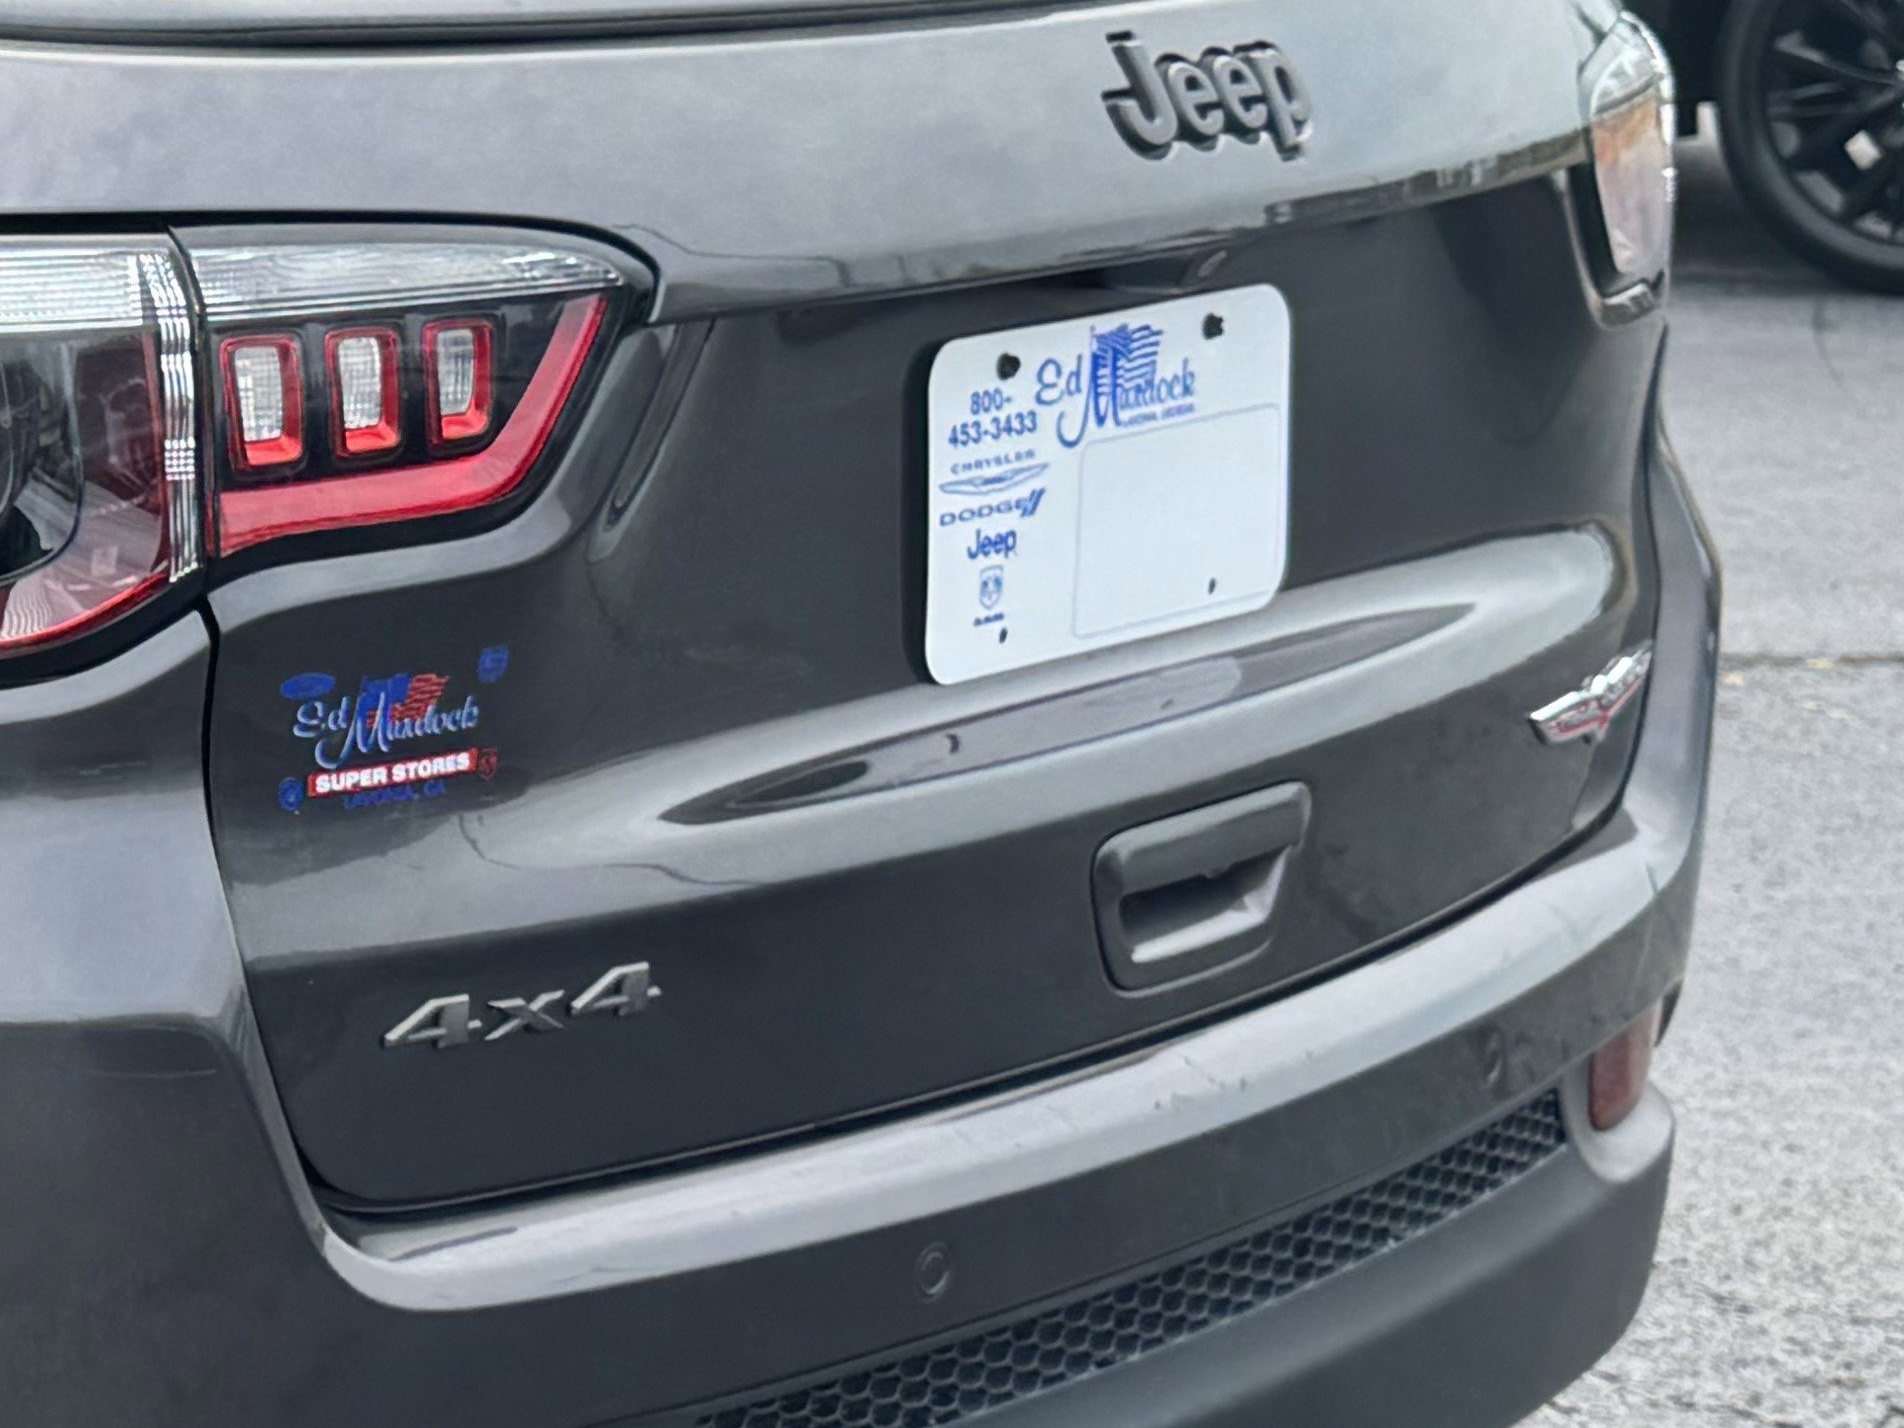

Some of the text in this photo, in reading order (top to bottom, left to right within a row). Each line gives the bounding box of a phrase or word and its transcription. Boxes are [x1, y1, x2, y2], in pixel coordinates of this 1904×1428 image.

[1100, 30, 1313, 162] Jeep
[1035, 354, 1083, 405] Ed
[969, 387, 1013, 416] 800-
[948, 409, 1038, 447] 453-3433
[939, 496, 1030, 527] DODGE
[966, 528, 1018, 560] Jeep
[293, 695, 350, 739] Ed
[315, 767, 388, 794] SUPER
[391, 752, 471, 782] STORES
